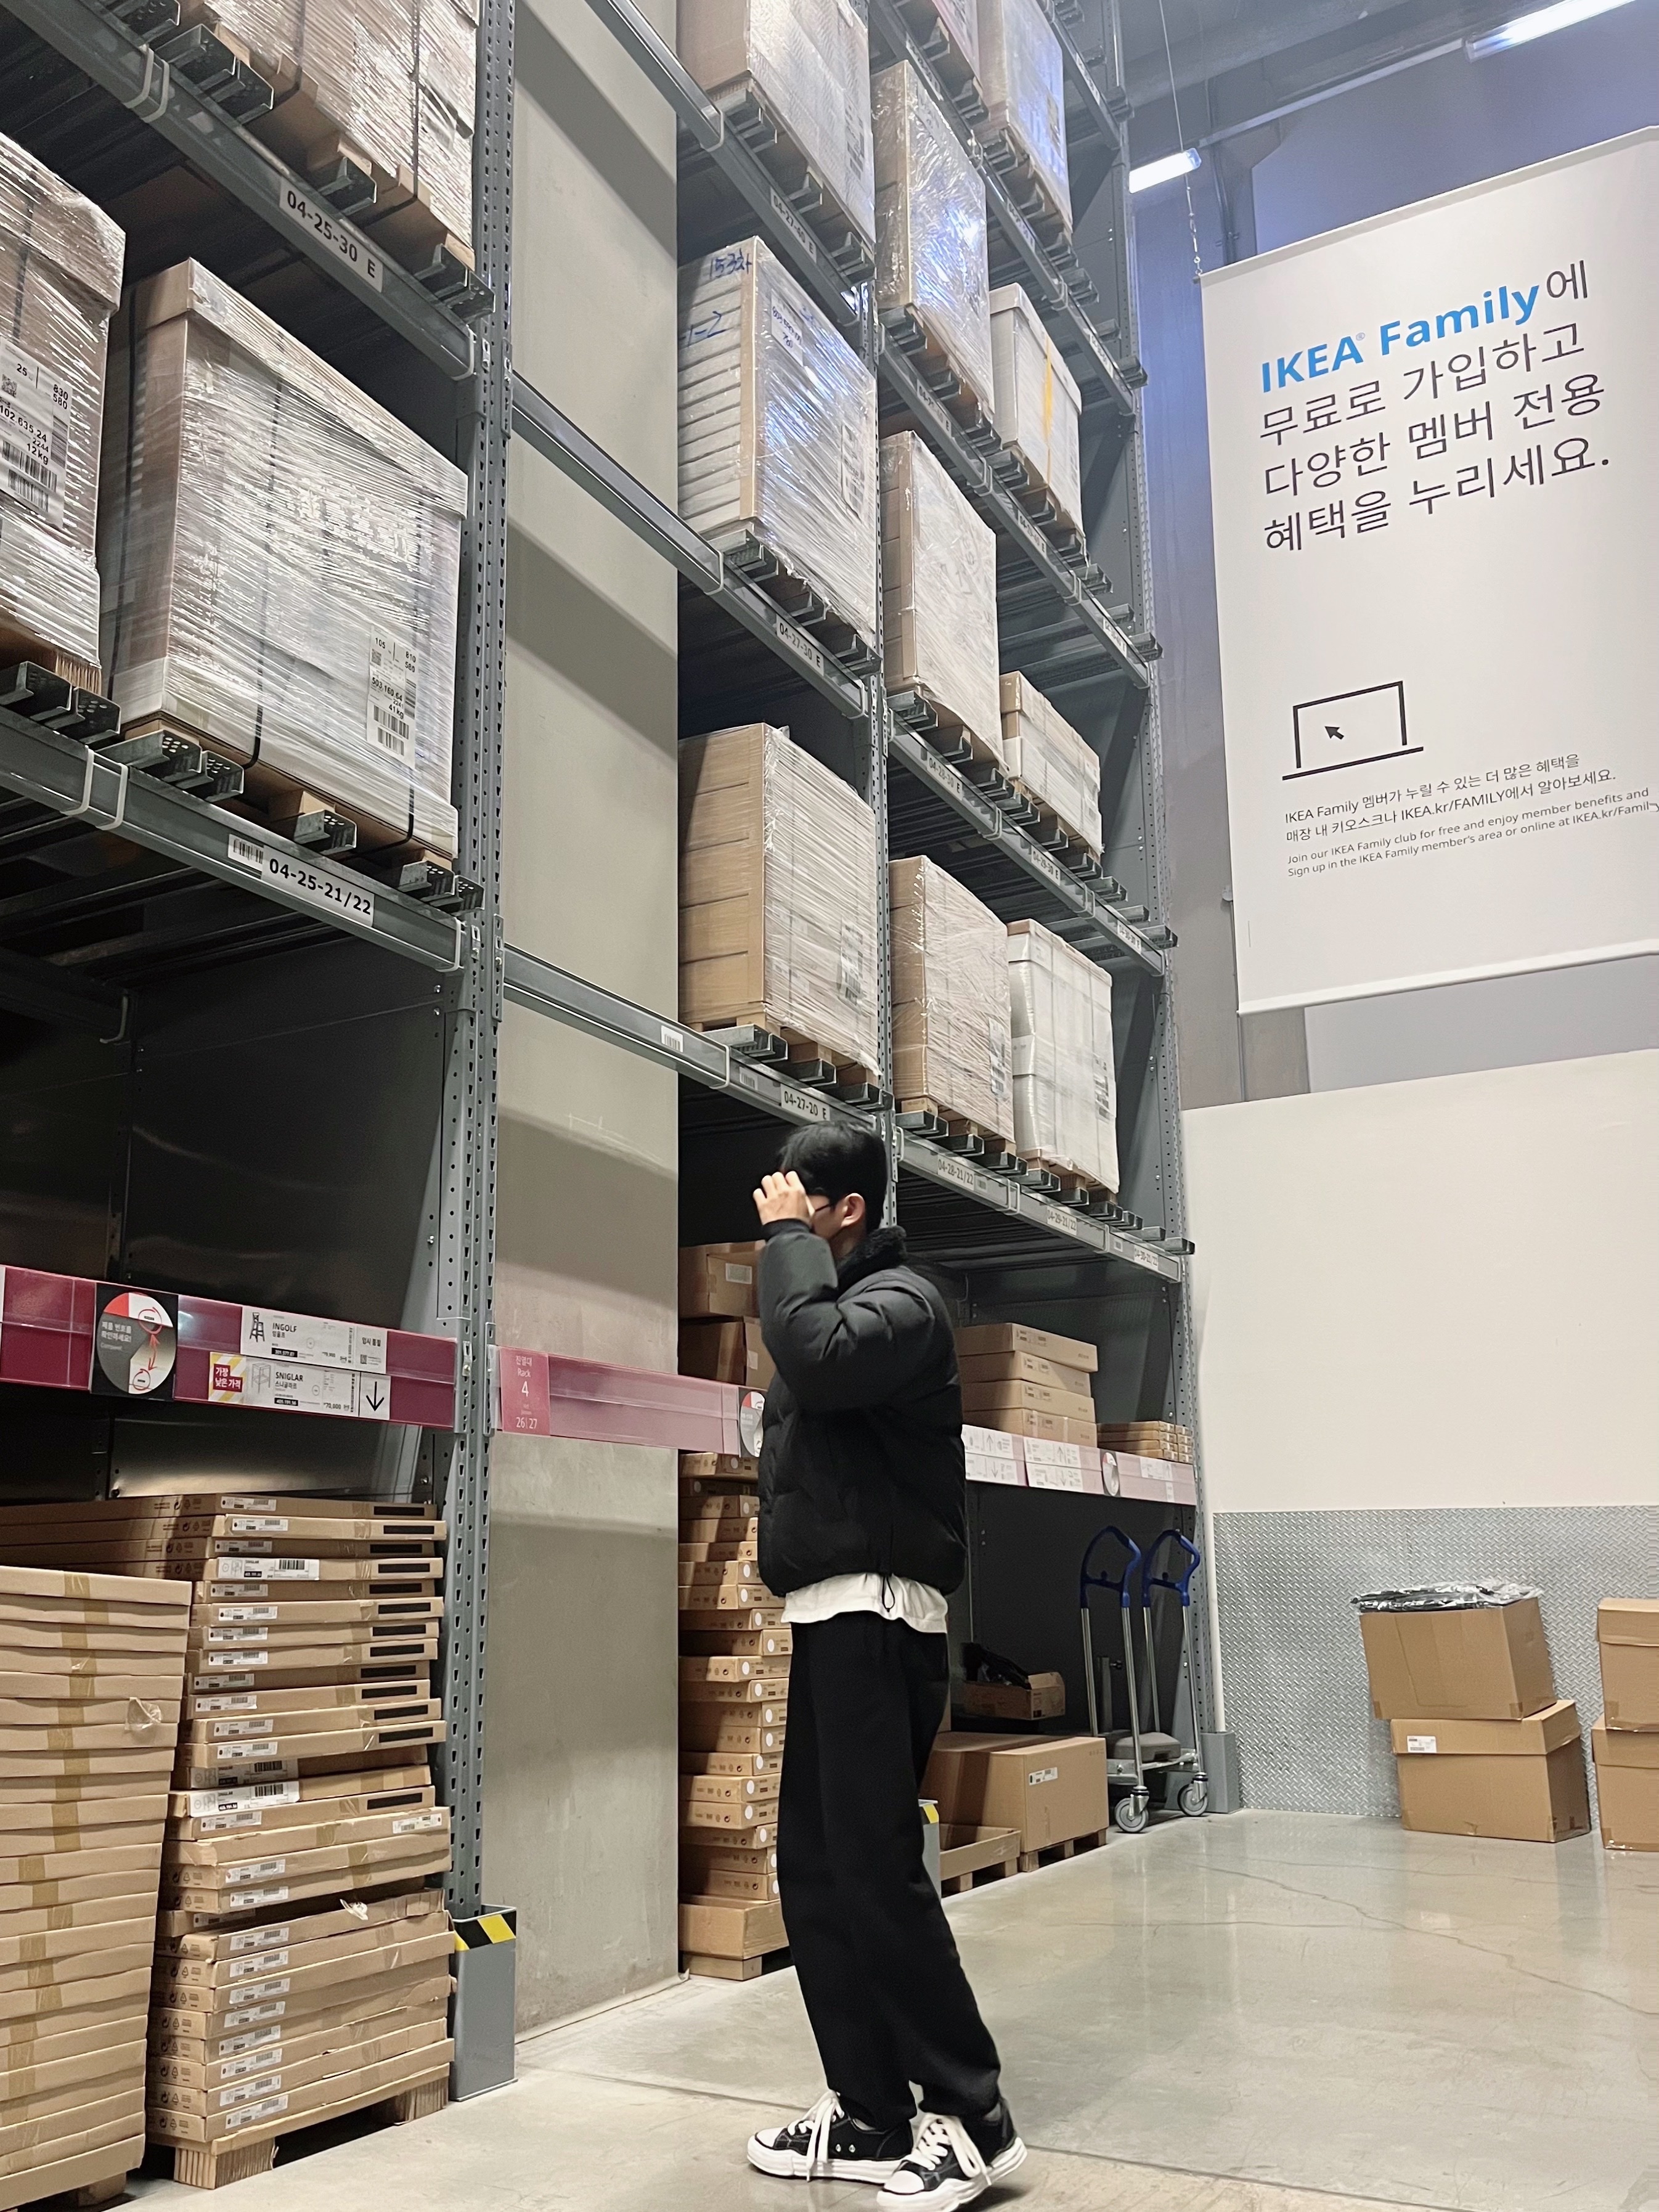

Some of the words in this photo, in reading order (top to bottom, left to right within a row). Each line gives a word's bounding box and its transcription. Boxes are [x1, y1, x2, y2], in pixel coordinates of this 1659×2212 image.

[287, 190, 357, 262] 04-25-30
[368, 259, 375, 278] E
[17, 363, 28, 377] 25
[53, 384, 68, 400] 830
[1260, 380, 1385, 446] 무료로
[1403, 323, 1584, 399] 가입하고
[53, 393, 68, 410] 580
[1265, 432, 1391, 496] 다양한
[1409, 401, 1493, 460] 멤버
[1514, 374, 1605, 430] 전용
[1265, 491, 1391, 550] 혜택을
[1409, 438, 1609, 514] 누리세요.
[375, 637, 386, 649] 105
[780, 622, 812, 660] 04-27-30
[817, 655, 821, 668] E
[405, 661, 415, 673] 580
[372, 677, 402, 701] 503.160.64
[1286, 809, 1314, 823] IKEA
[1318, 801, 1359, 817] Family
[1363, 790, 1402, 809] 멤버가
[1406, 783, 1432, 799] 누릴
[1437, 781, 1450, 794] 수
[1454, 775, 1482, 790] 있는
[1486, 770, 1499, 783] 더
[1504, 764, 1532, 780] 많은
[1536, 754, 1580, 772] 혜택을
[1287, 827, 1311, 842] 매장
[1315, 824, 1327, 836] 내
[1332, 810, 1397, 833] 키오스크나
[1401, 783, 1533, 820] IKEA.kr/FAMILY에서
[1538, 769, 1616, 794] 알아보세요.
[1288, 854, 1308, 864] Join
[1311, 850, 1329, 860] our
[1331, 844, 1355, 855] IKEA
[1358, 838, 1392, 852] Family
[1395, 832, 1417, 844] club
[1420, 830, 1435, 839] for
[1439, 825, 1461, 836] free
[1464, 819, 1485, 831] and
[1488, 814, 1518, 826] enjoy
[1522, 804, 1571, 820] member
[1575, 794, 1623, 810] benefits
[1626, 788, 1649, 801] and
[1288, 867, 1310, 878] Sign
[1313, 864, 1326, 873] up
[1328, 860, 1337, 869] in
[1340, 857, 1356, 867] the
[1359, 852, 1382, 863] IKEA
[1386, 845, 1419, 859] Family
[1422, 836, 1475, 852] member's
[1478, 831, 1502, 842] area
[1506, 828, 1517, 836] or
[1520, 821, 1555, 833] online
[1559, 817, 1570, 826] at
[269, 859, 371, 915] 04-25-21/22
[785, 1091, 818, 1116] 04-27-20
[823, 1108, 826, 1119] E
[272, 1323, 297, 1333] INGOLF
[215, 1377, 227, 1388] 낮은
[228, 1379, 241, 1389] 가격
[216, 1367, 229, 1377] 가장
[275, 1372, 303, 1382] SNIGLAR
[518, 1368, 531, 1377] Rack
[521, 1381, 529, 1397] 4
